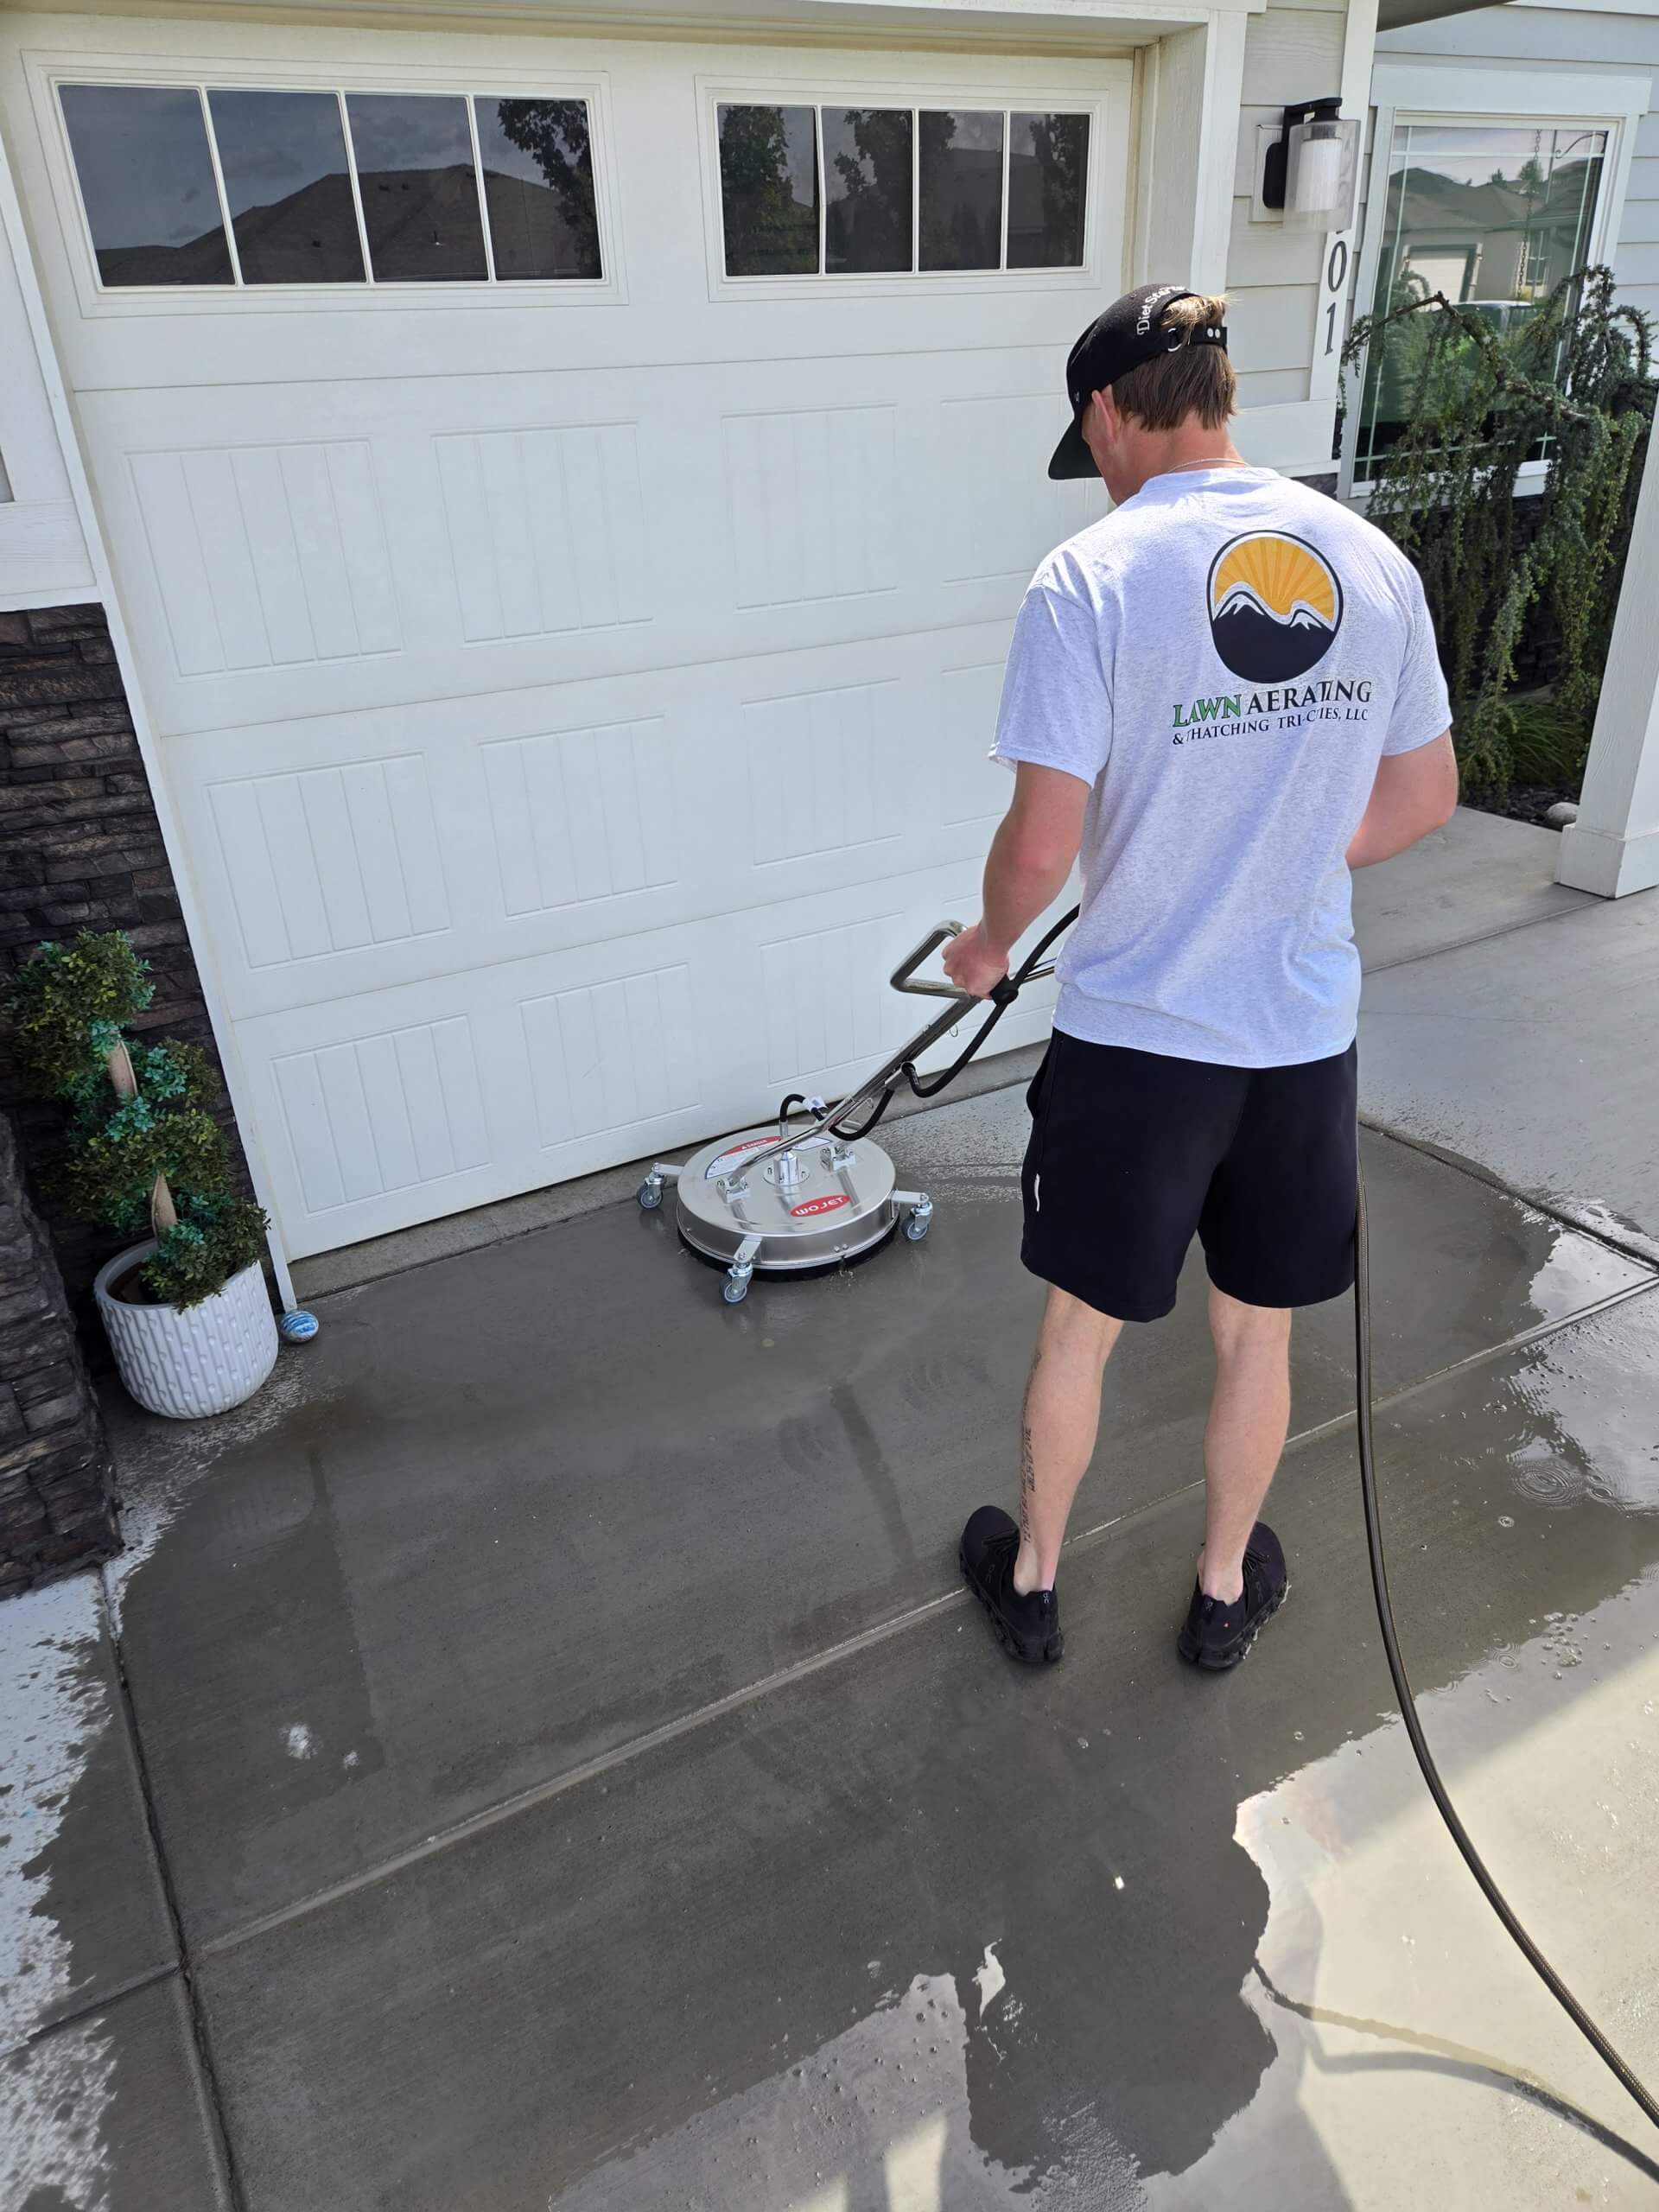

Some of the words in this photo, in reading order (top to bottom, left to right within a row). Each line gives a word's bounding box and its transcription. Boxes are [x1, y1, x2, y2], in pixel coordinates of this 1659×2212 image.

[1136, 304, 1153, 335] Diet
[1173, 694, 1242, 728] LAWN
[1244, 679, 1372, 715] AERATING
[1173, 732, 1184, 745] &
[1345, 708, 1369, 721] LLC
[795, 1197, 843, 1216] WOJET
